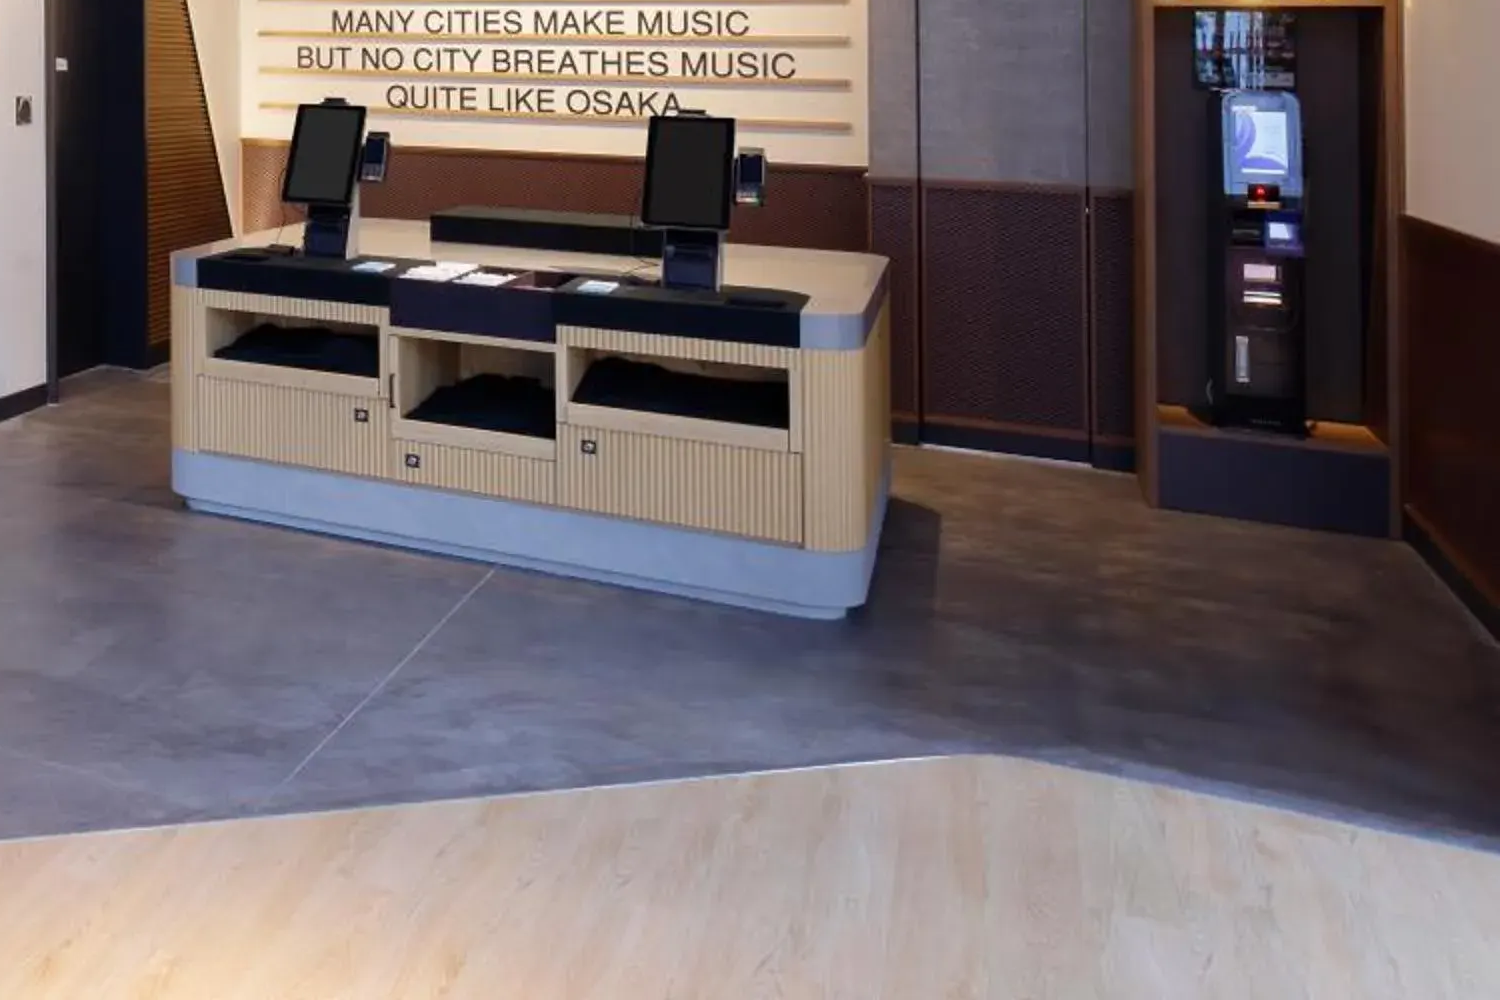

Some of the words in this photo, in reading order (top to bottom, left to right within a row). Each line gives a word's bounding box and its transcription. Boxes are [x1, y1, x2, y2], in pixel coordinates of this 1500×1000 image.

[331, 9, 415, 35] MANY
[424, 9, 523, 35] CITIES
[533, 10, 625, 36] MAKE
[637, 10, 750, 37] MUSIC
[297, 45, 352, 71] BUT
[361, 47, 404, 71] NO
[413, 47, 482, 73] CITY
[492, 49, 669, 78] BREATHES
[681, 51, 796, 80] MUSIC
[386, 84, 477, 110] QUITE
[488, 87, 555, 114] LIKE
[566, 89, 682, 116] OSAKA
